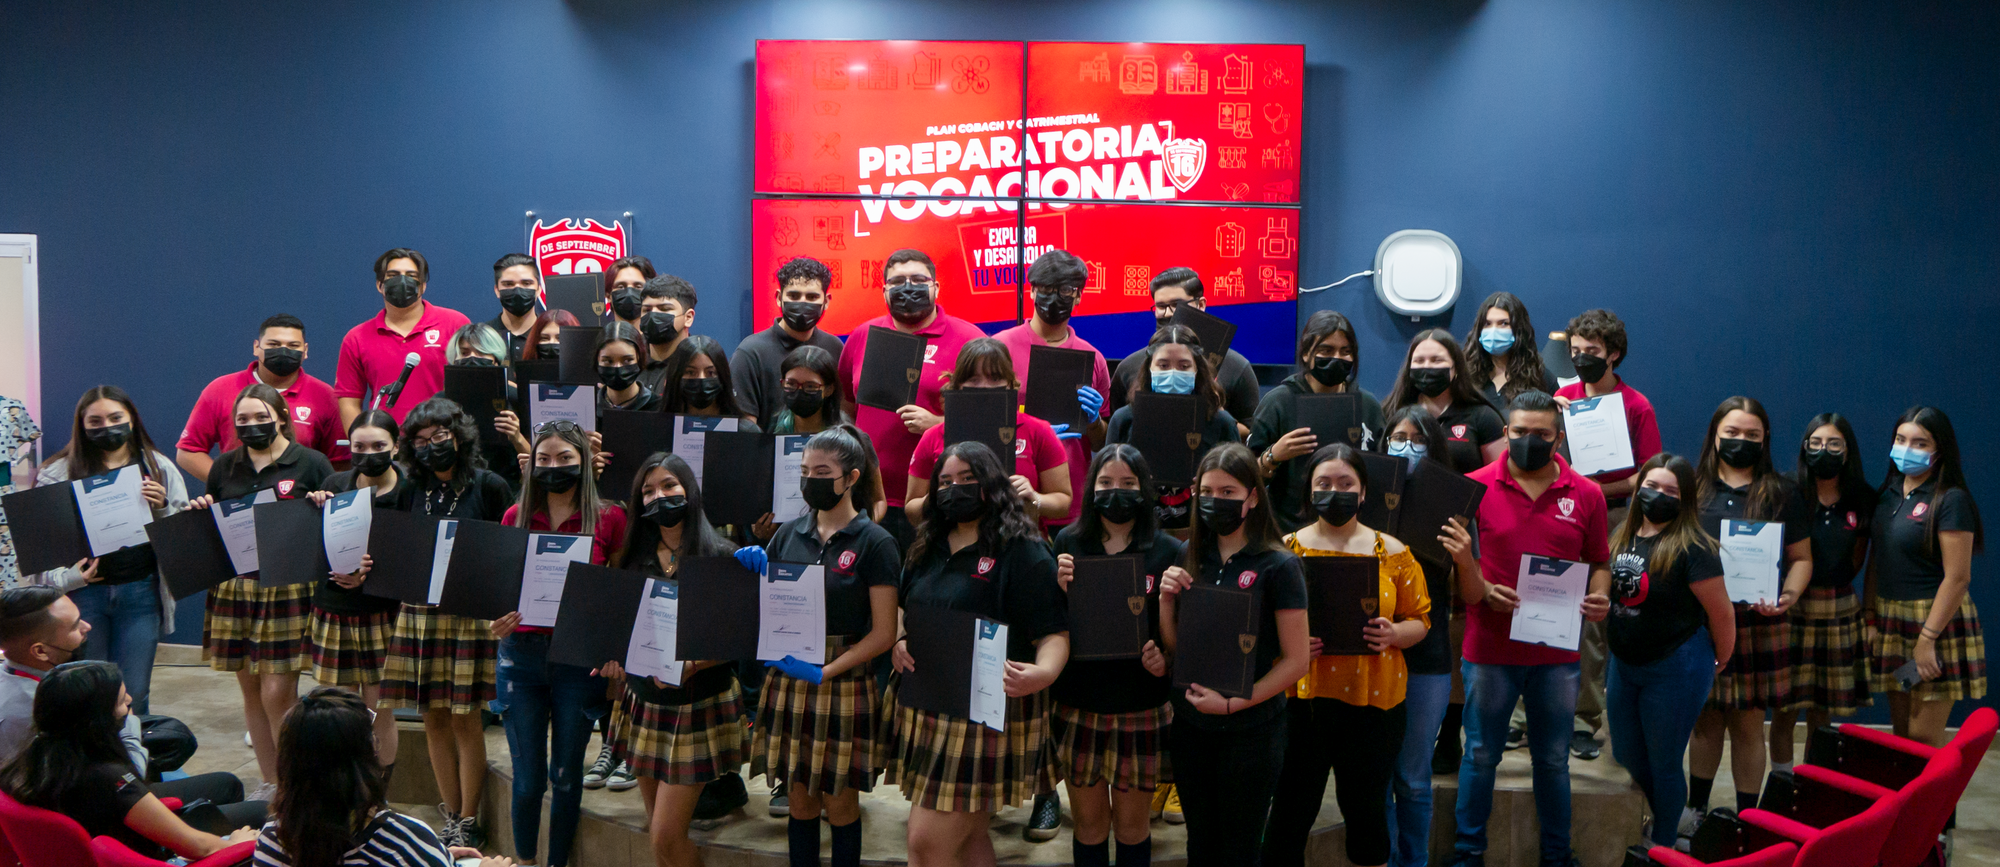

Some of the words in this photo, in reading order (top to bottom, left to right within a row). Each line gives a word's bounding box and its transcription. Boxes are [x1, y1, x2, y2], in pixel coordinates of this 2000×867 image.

[926, 124, 956, 136] PLAN
[957, 121, 1004, 133] COBACH
[1006, 119, 1015, 130] Y
[858, 123, 1164, 179] PREPARATORIA
[1170, 155, 1195, 177] 16
[857, 160, 1176, 224] VOCACIONAL
[988, 226, 1037, 247] EXPLRA
[540, 243, 554, 254] DE
[556, 240, 616, 256] SEPTIEMBRE
[973, 249, 982, 268] Y
[972, 269, 989, 287] TU
[540, 410, 578, 418] CONSTANCIA
[535, 564, 567, 573] CONSTANC
[769, 593, 808, 603] CONSTANCIA
[1527, 584, 1567, 595] CONSTANCIA
